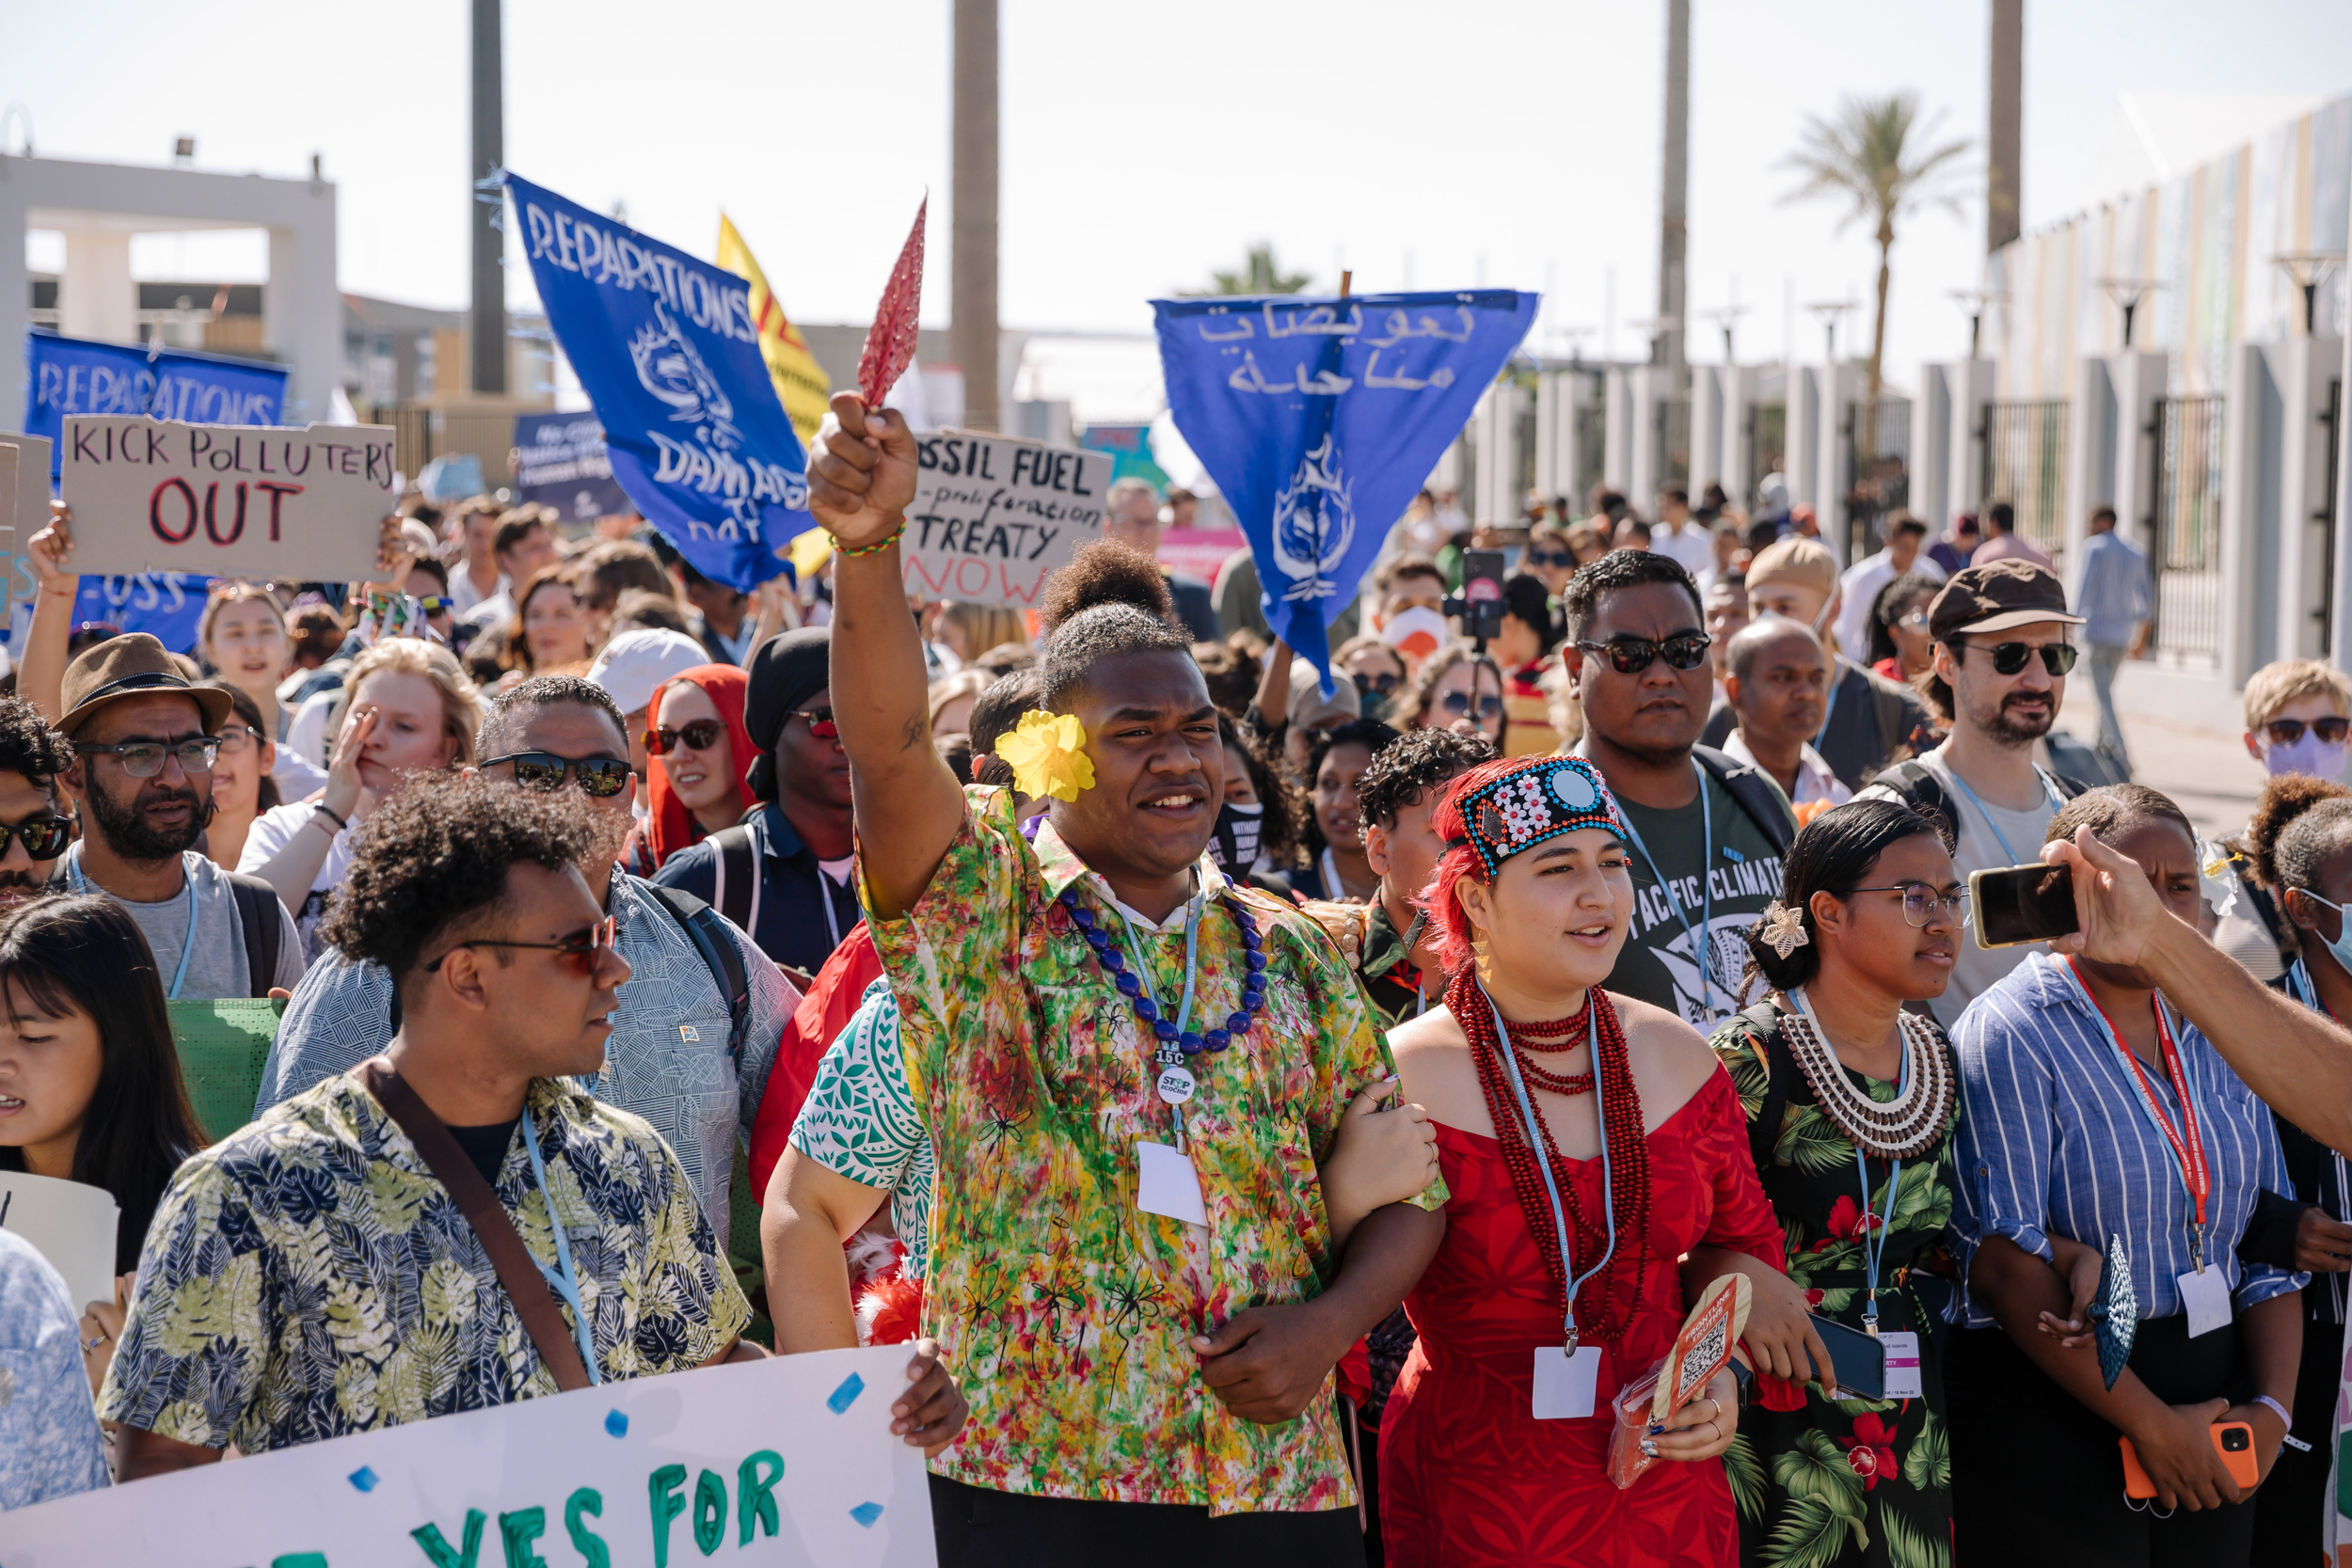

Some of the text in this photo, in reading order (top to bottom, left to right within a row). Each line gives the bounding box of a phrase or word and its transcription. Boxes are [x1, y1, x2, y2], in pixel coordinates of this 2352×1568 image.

[526, 202, 758, 345] REPARATIONS
[38, 361, 275, 426] REPARATIONS
[73, 423, 170, 465] KICK
[646, 429, 809, 513] DAMAG
[1011, 448, 1091, 496] FUEL
[149, 476, 305, 547] OUT
[914, 515, 1059, 561] TREATY
[903, 554, 1048, 604] NOW
[1160, 1084, 1189, 1097] ECOCIDE
[1163, 1075, 1191, 1089] STOP
[2140, 1099, 2159, 1127] UNFCCC
[1533, 1132, 1568, 1257] UNFCCC unfccc.int
[1685, 1289, 1730, 1343] FRONTLINE
[1692, 1306, 1724, 1343] TRUTHS
[410, 1450, 786, 1568] YES FOR
